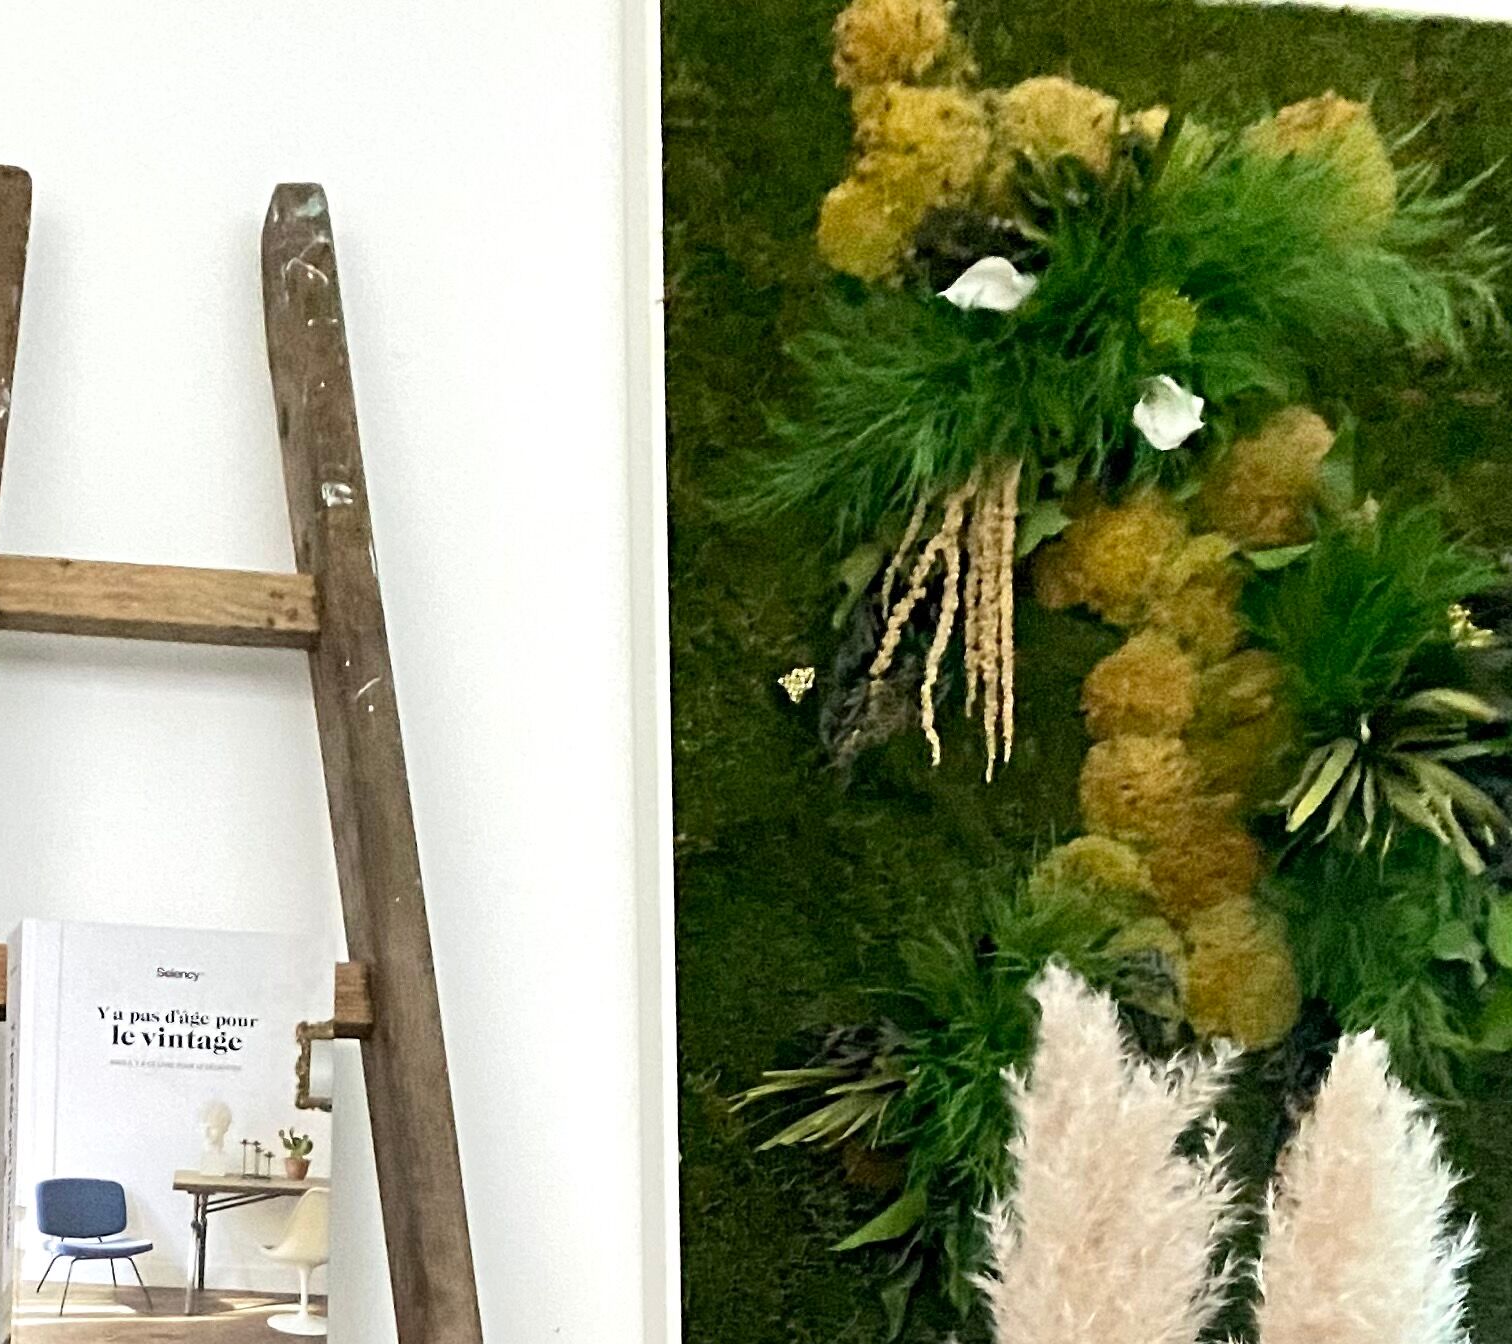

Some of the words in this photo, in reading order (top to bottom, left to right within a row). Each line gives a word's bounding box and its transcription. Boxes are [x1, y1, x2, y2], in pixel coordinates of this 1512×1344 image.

[130, 1010, 160, 1024] pas
[216, 1015, 258, 1029] pour
[112, 1024, 135, 1046] le
[142, 1027, 243, 1055] vintage
